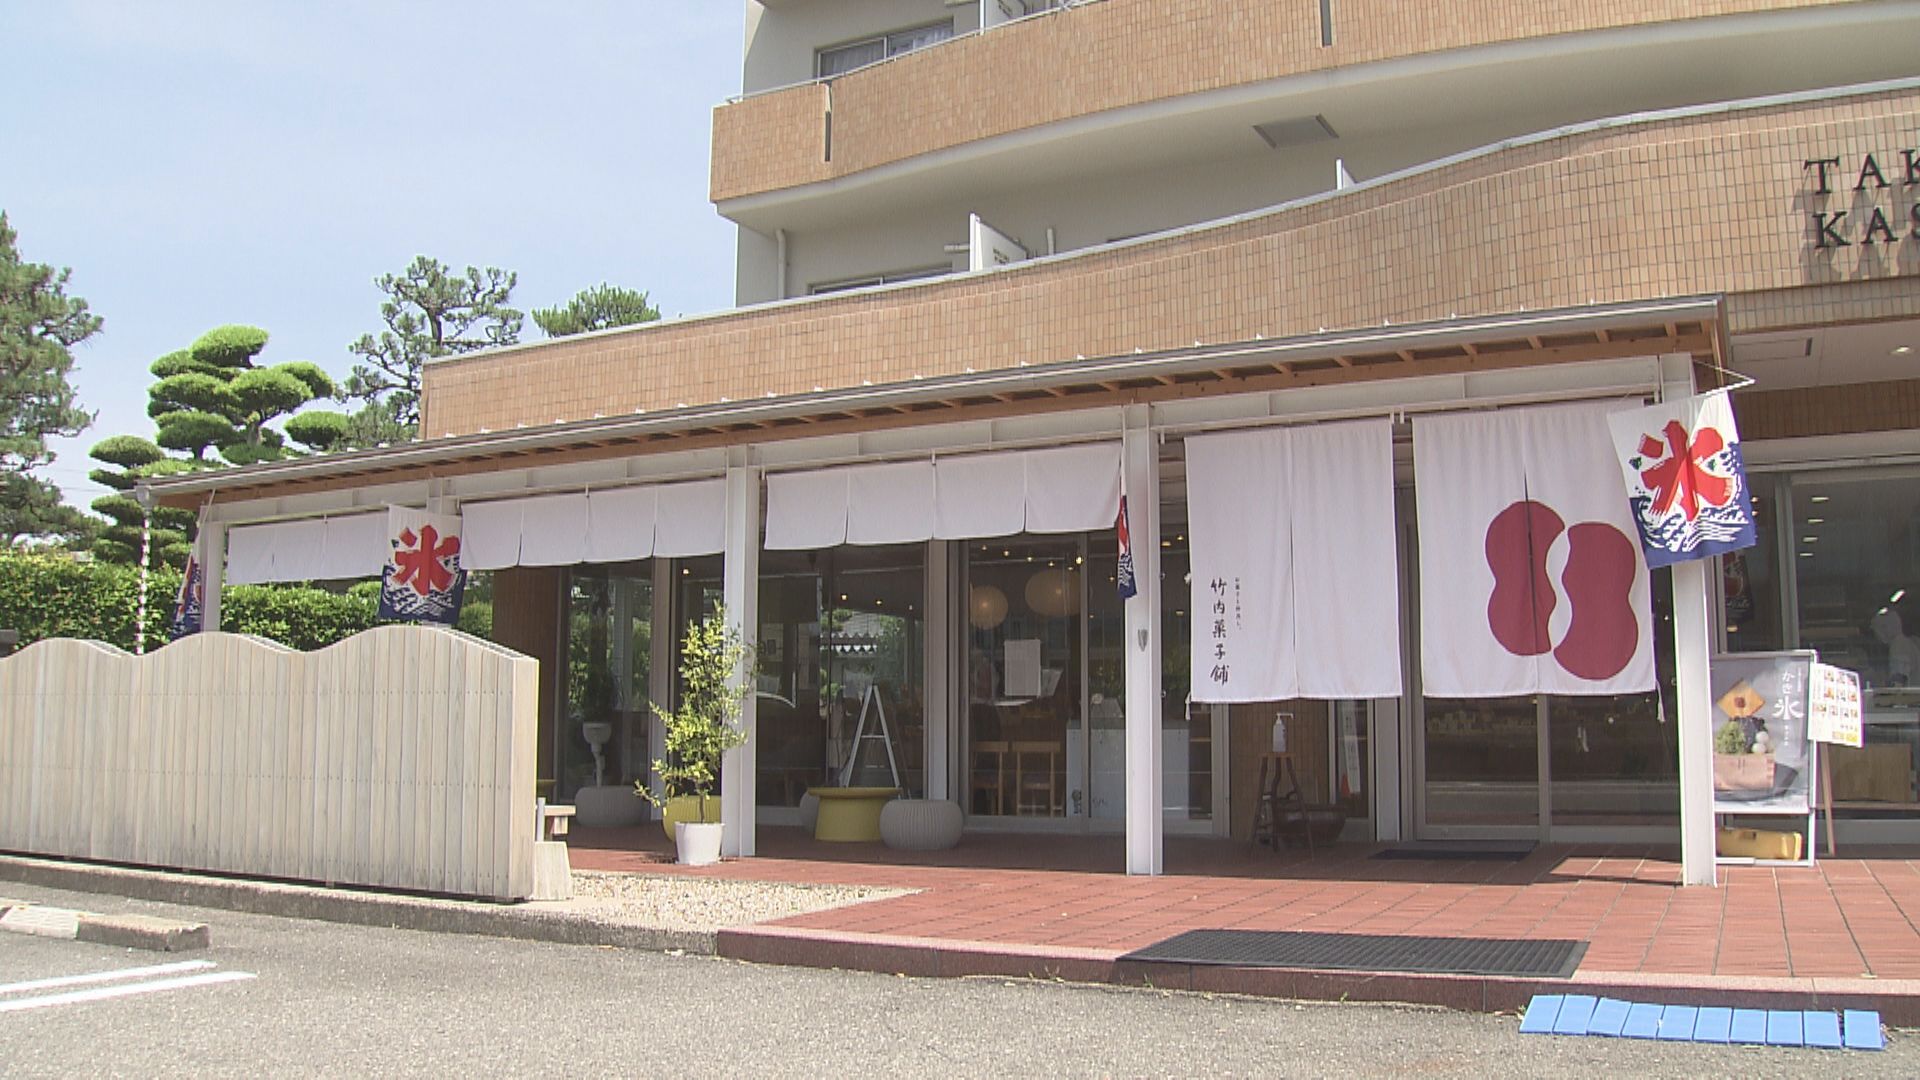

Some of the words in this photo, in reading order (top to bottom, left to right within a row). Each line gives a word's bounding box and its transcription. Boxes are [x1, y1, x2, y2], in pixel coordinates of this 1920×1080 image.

[1637, 420, 1733, 522] 氷
[391, 524, 461, 596] 氷
[1210, 577, 1229, 685] 竹内菓子舗
